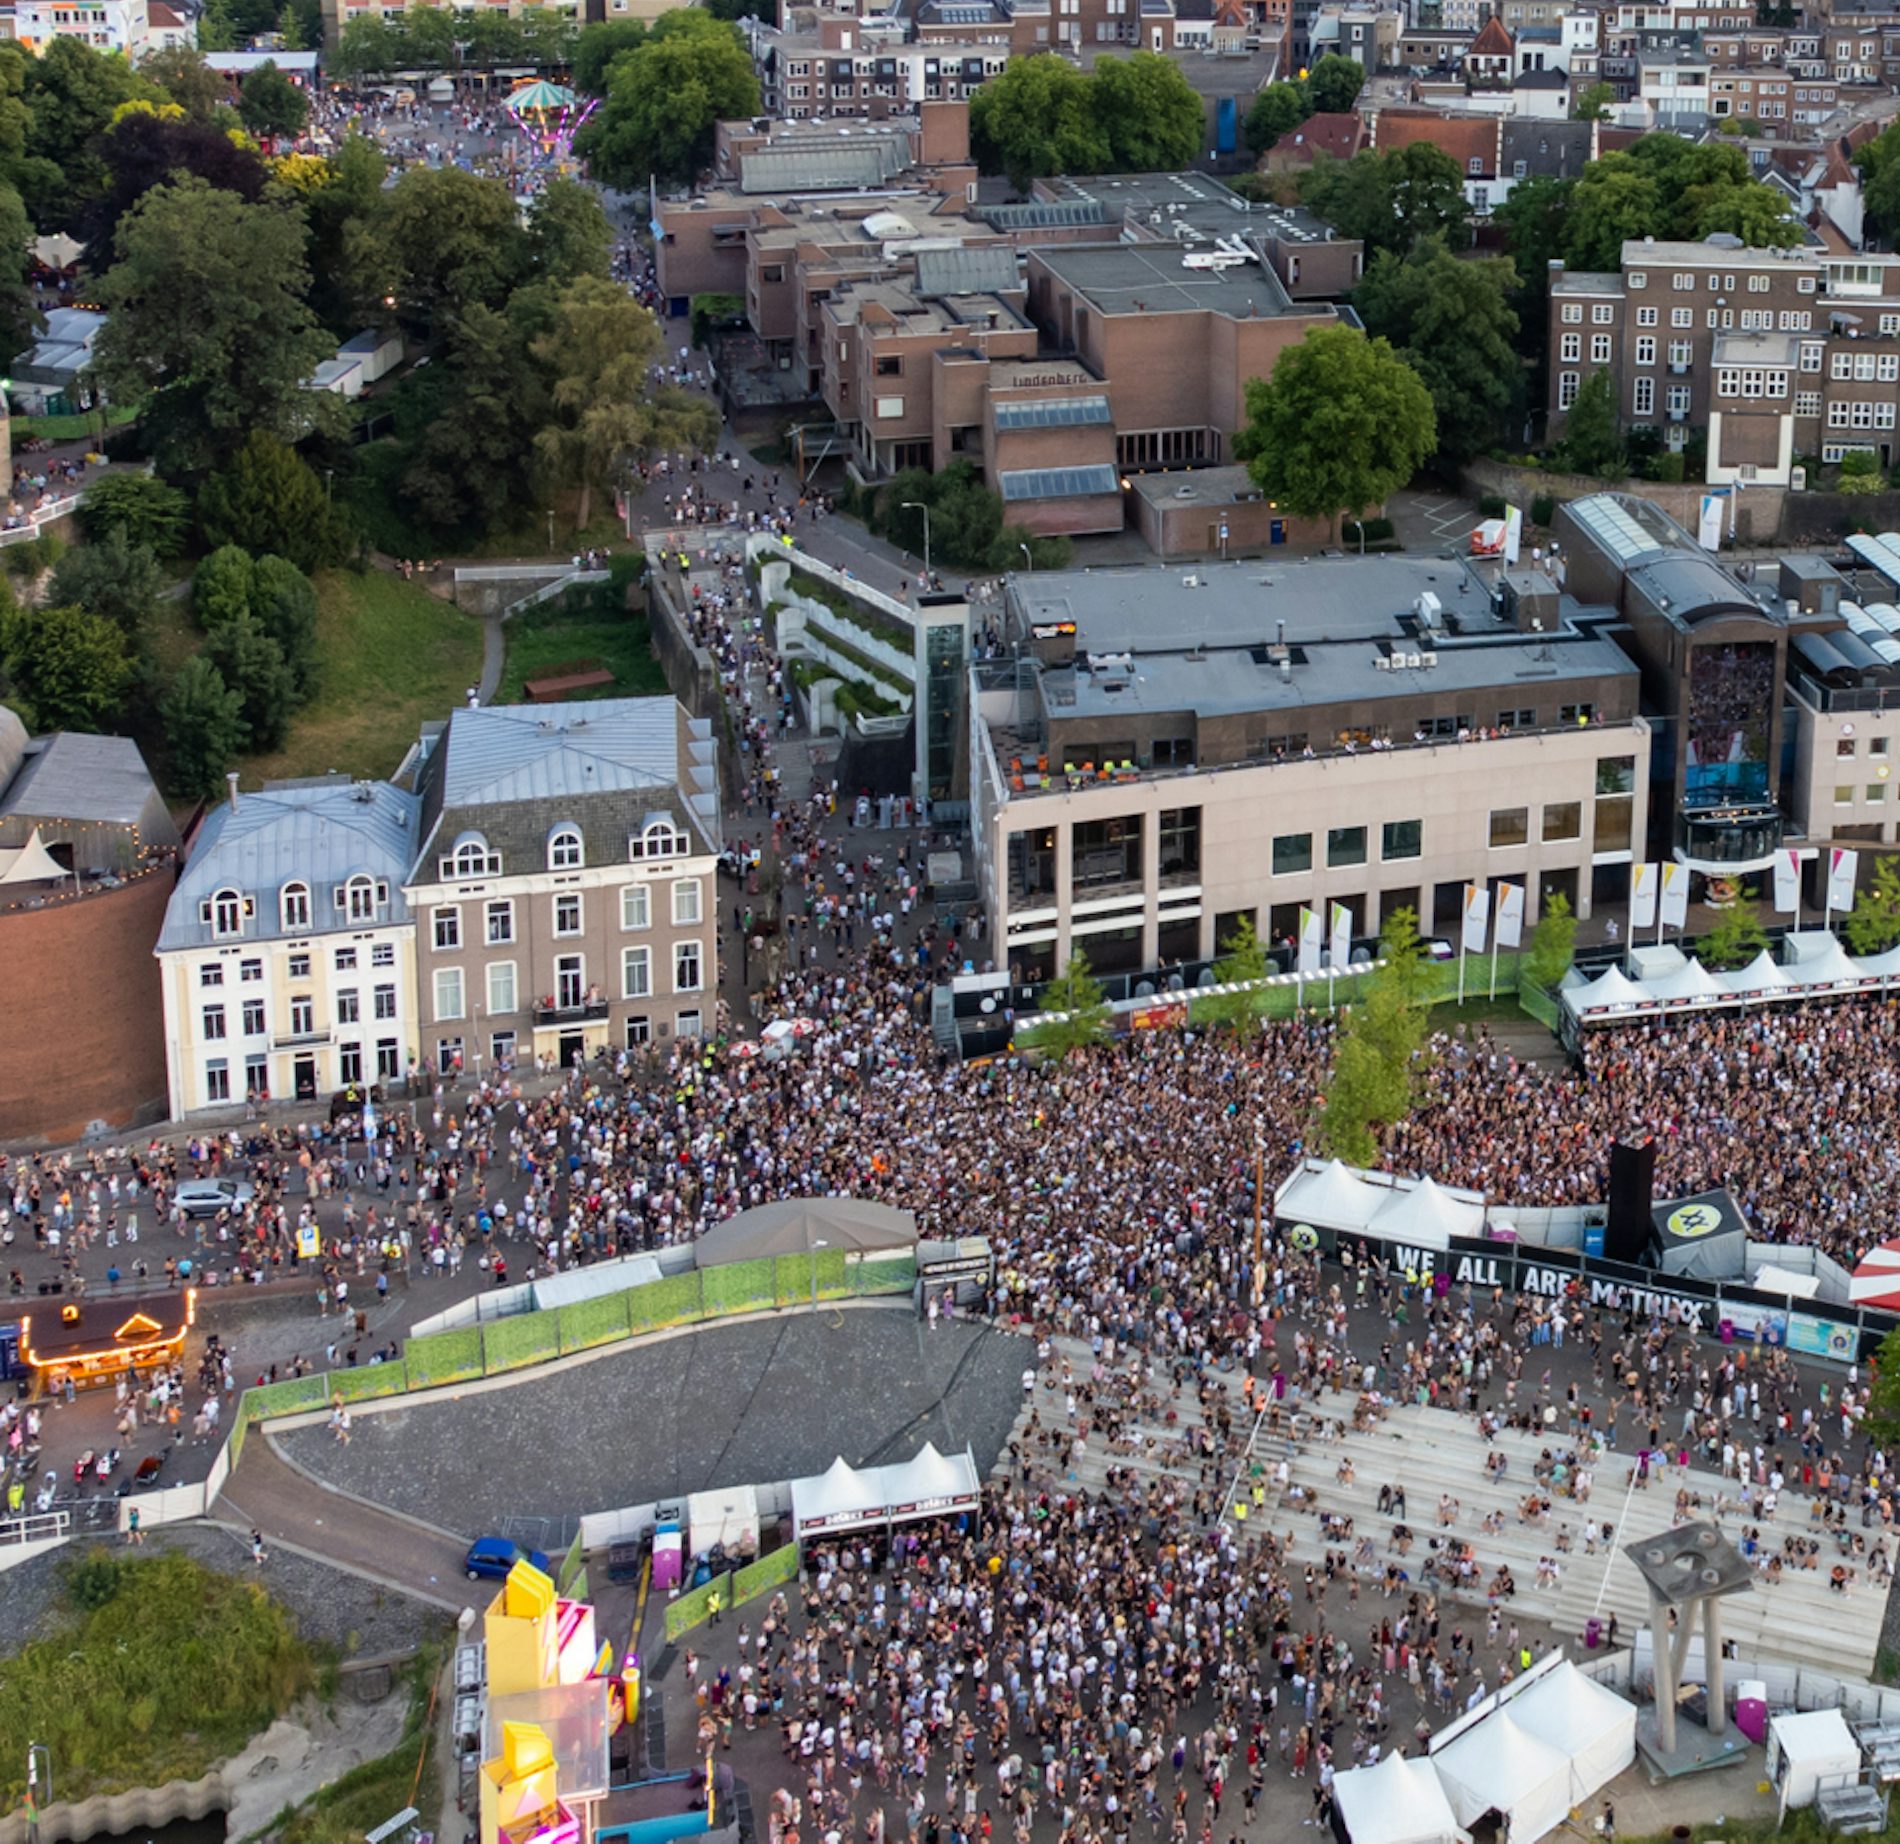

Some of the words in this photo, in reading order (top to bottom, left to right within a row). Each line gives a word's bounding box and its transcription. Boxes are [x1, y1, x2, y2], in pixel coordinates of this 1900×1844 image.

[1396, 1245, 1435, 1274] WE
[1456, 1256, 1501, 1286] ALL
[1523, 1266, 1571, 1297] ARE
